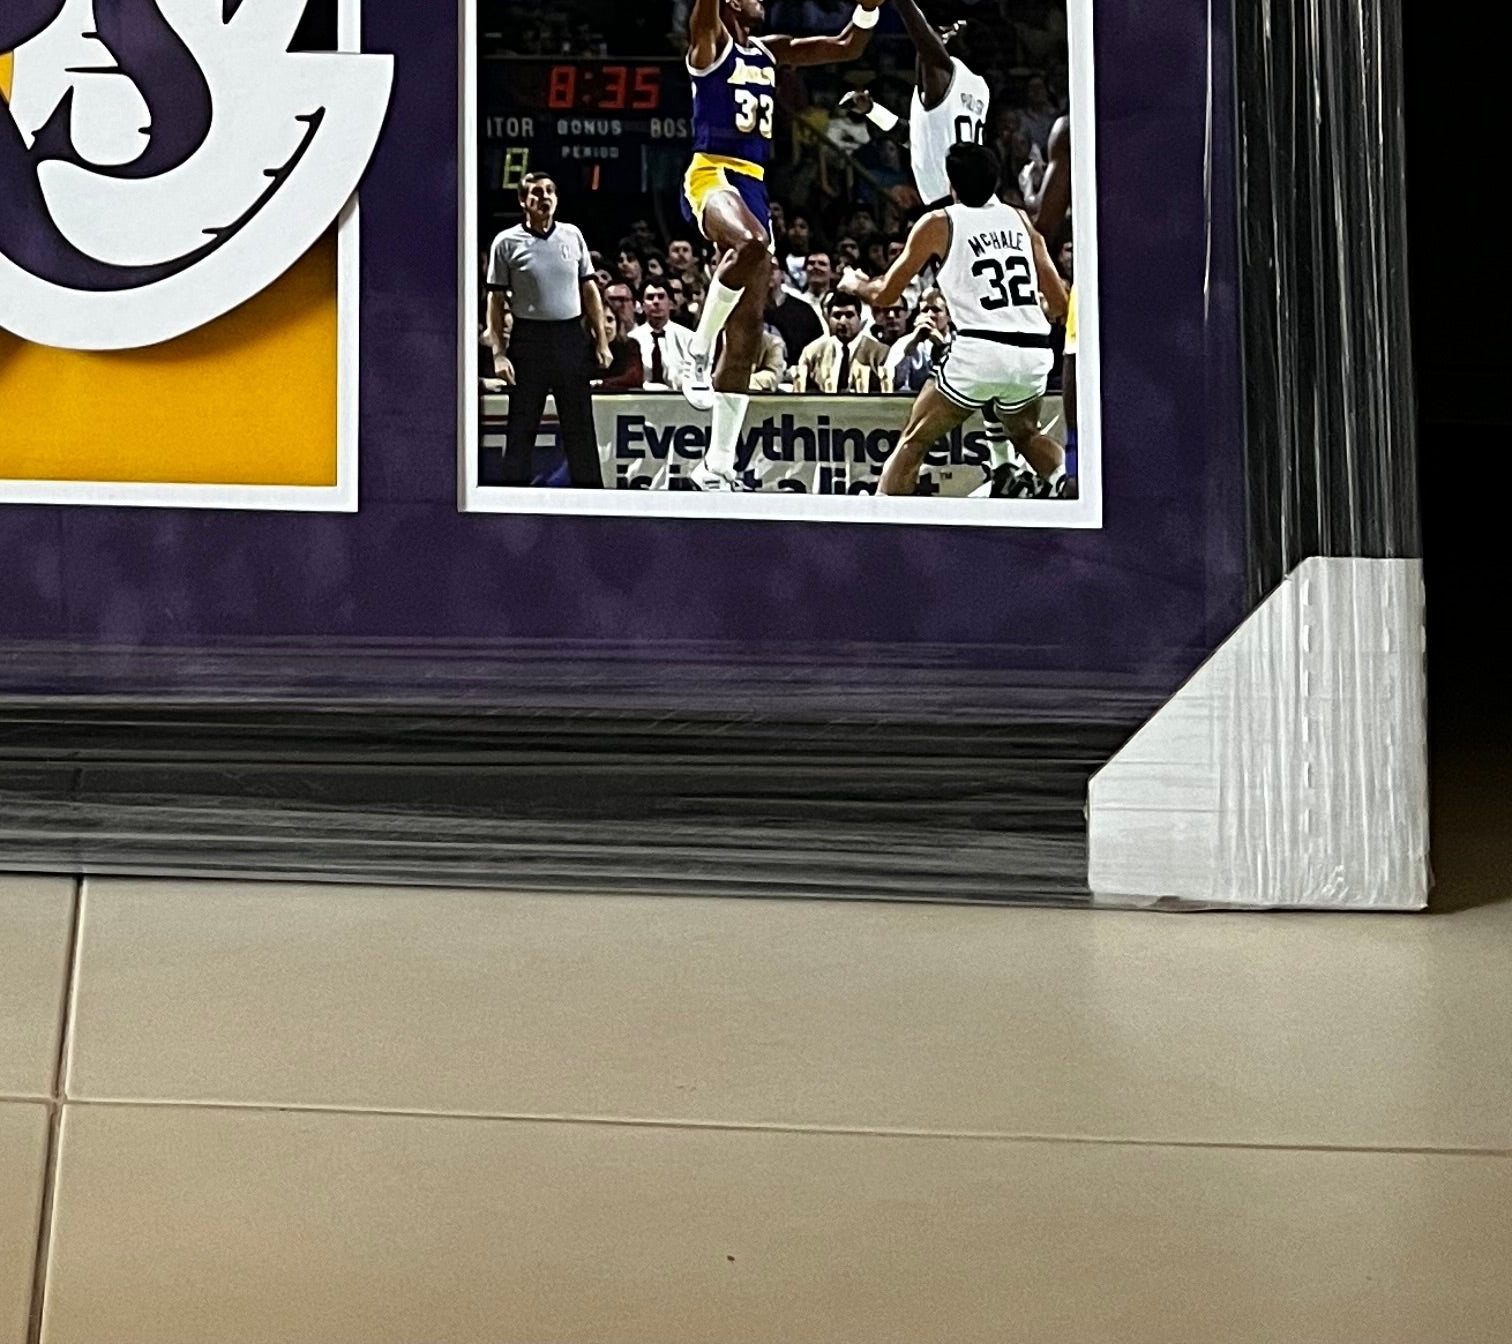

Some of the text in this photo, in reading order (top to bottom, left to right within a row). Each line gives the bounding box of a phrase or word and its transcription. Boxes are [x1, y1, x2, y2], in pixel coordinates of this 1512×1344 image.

[547, 65, 661, 109] 8:35
[556, 118, 622, 136] BONUS
[735, 88, 774, 139] 33
[971, 255, 1039, 311] 32
[616, 413, 902, 473] Eveything
